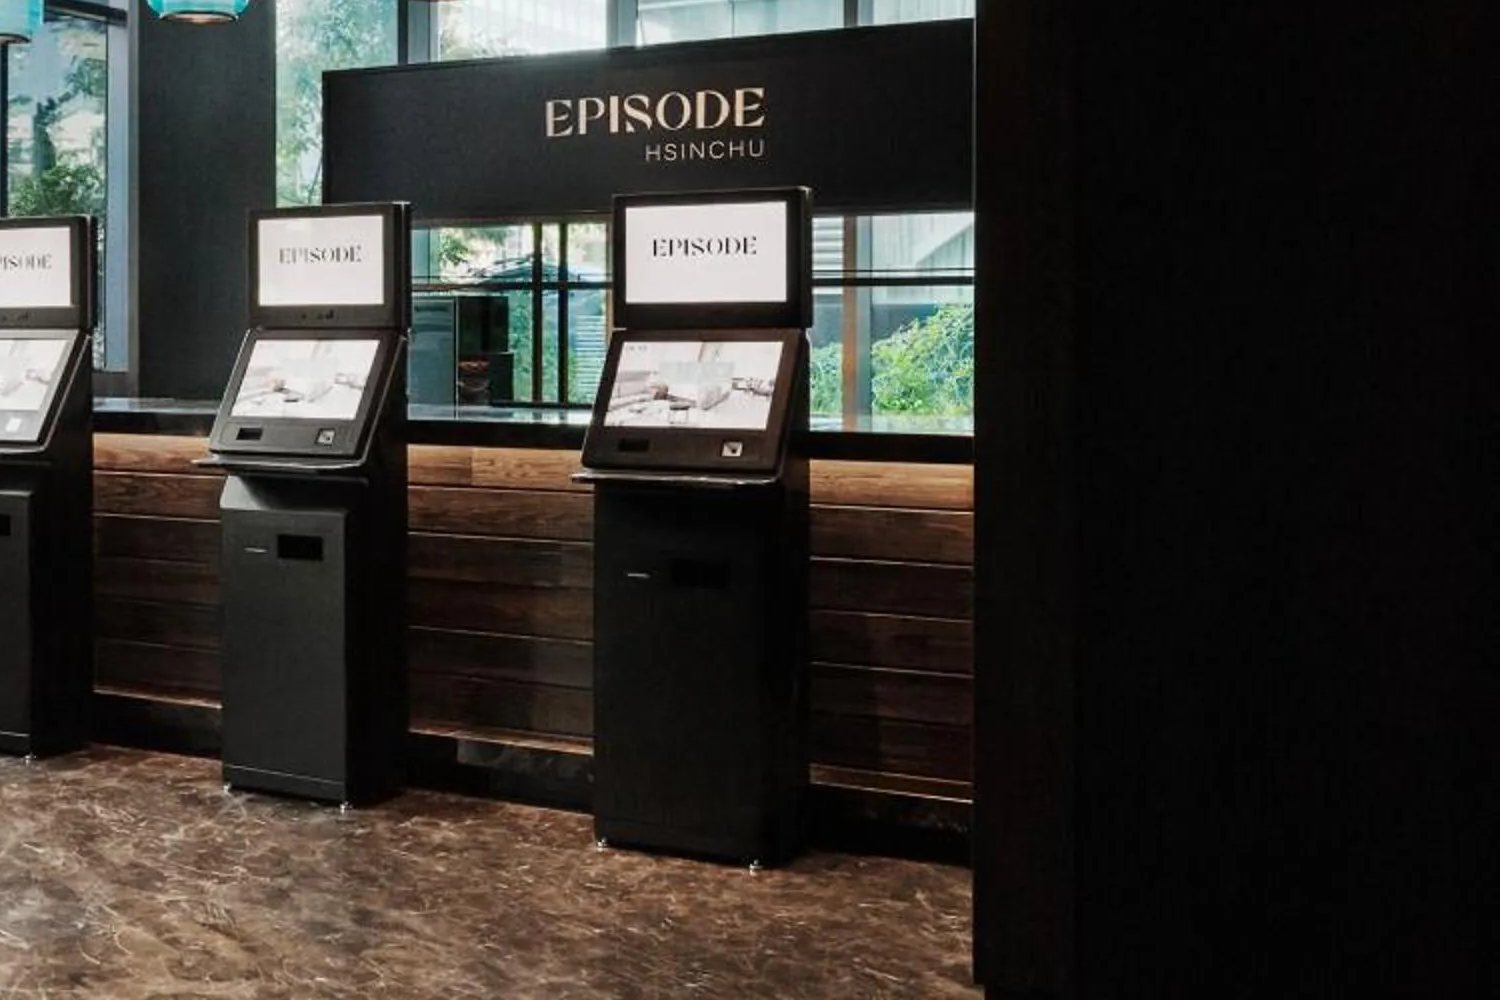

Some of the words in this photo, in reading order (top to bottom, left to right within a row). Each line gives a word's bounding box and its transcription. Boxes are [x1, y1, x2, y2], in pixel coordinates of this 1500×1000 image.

[545, 87, 765, 137] EPISODE
[645, 139, 765, 162] HSINCHU
[279, 244, 362, 265] EPISODE
[652, 235, 757, 257] EPISODE
